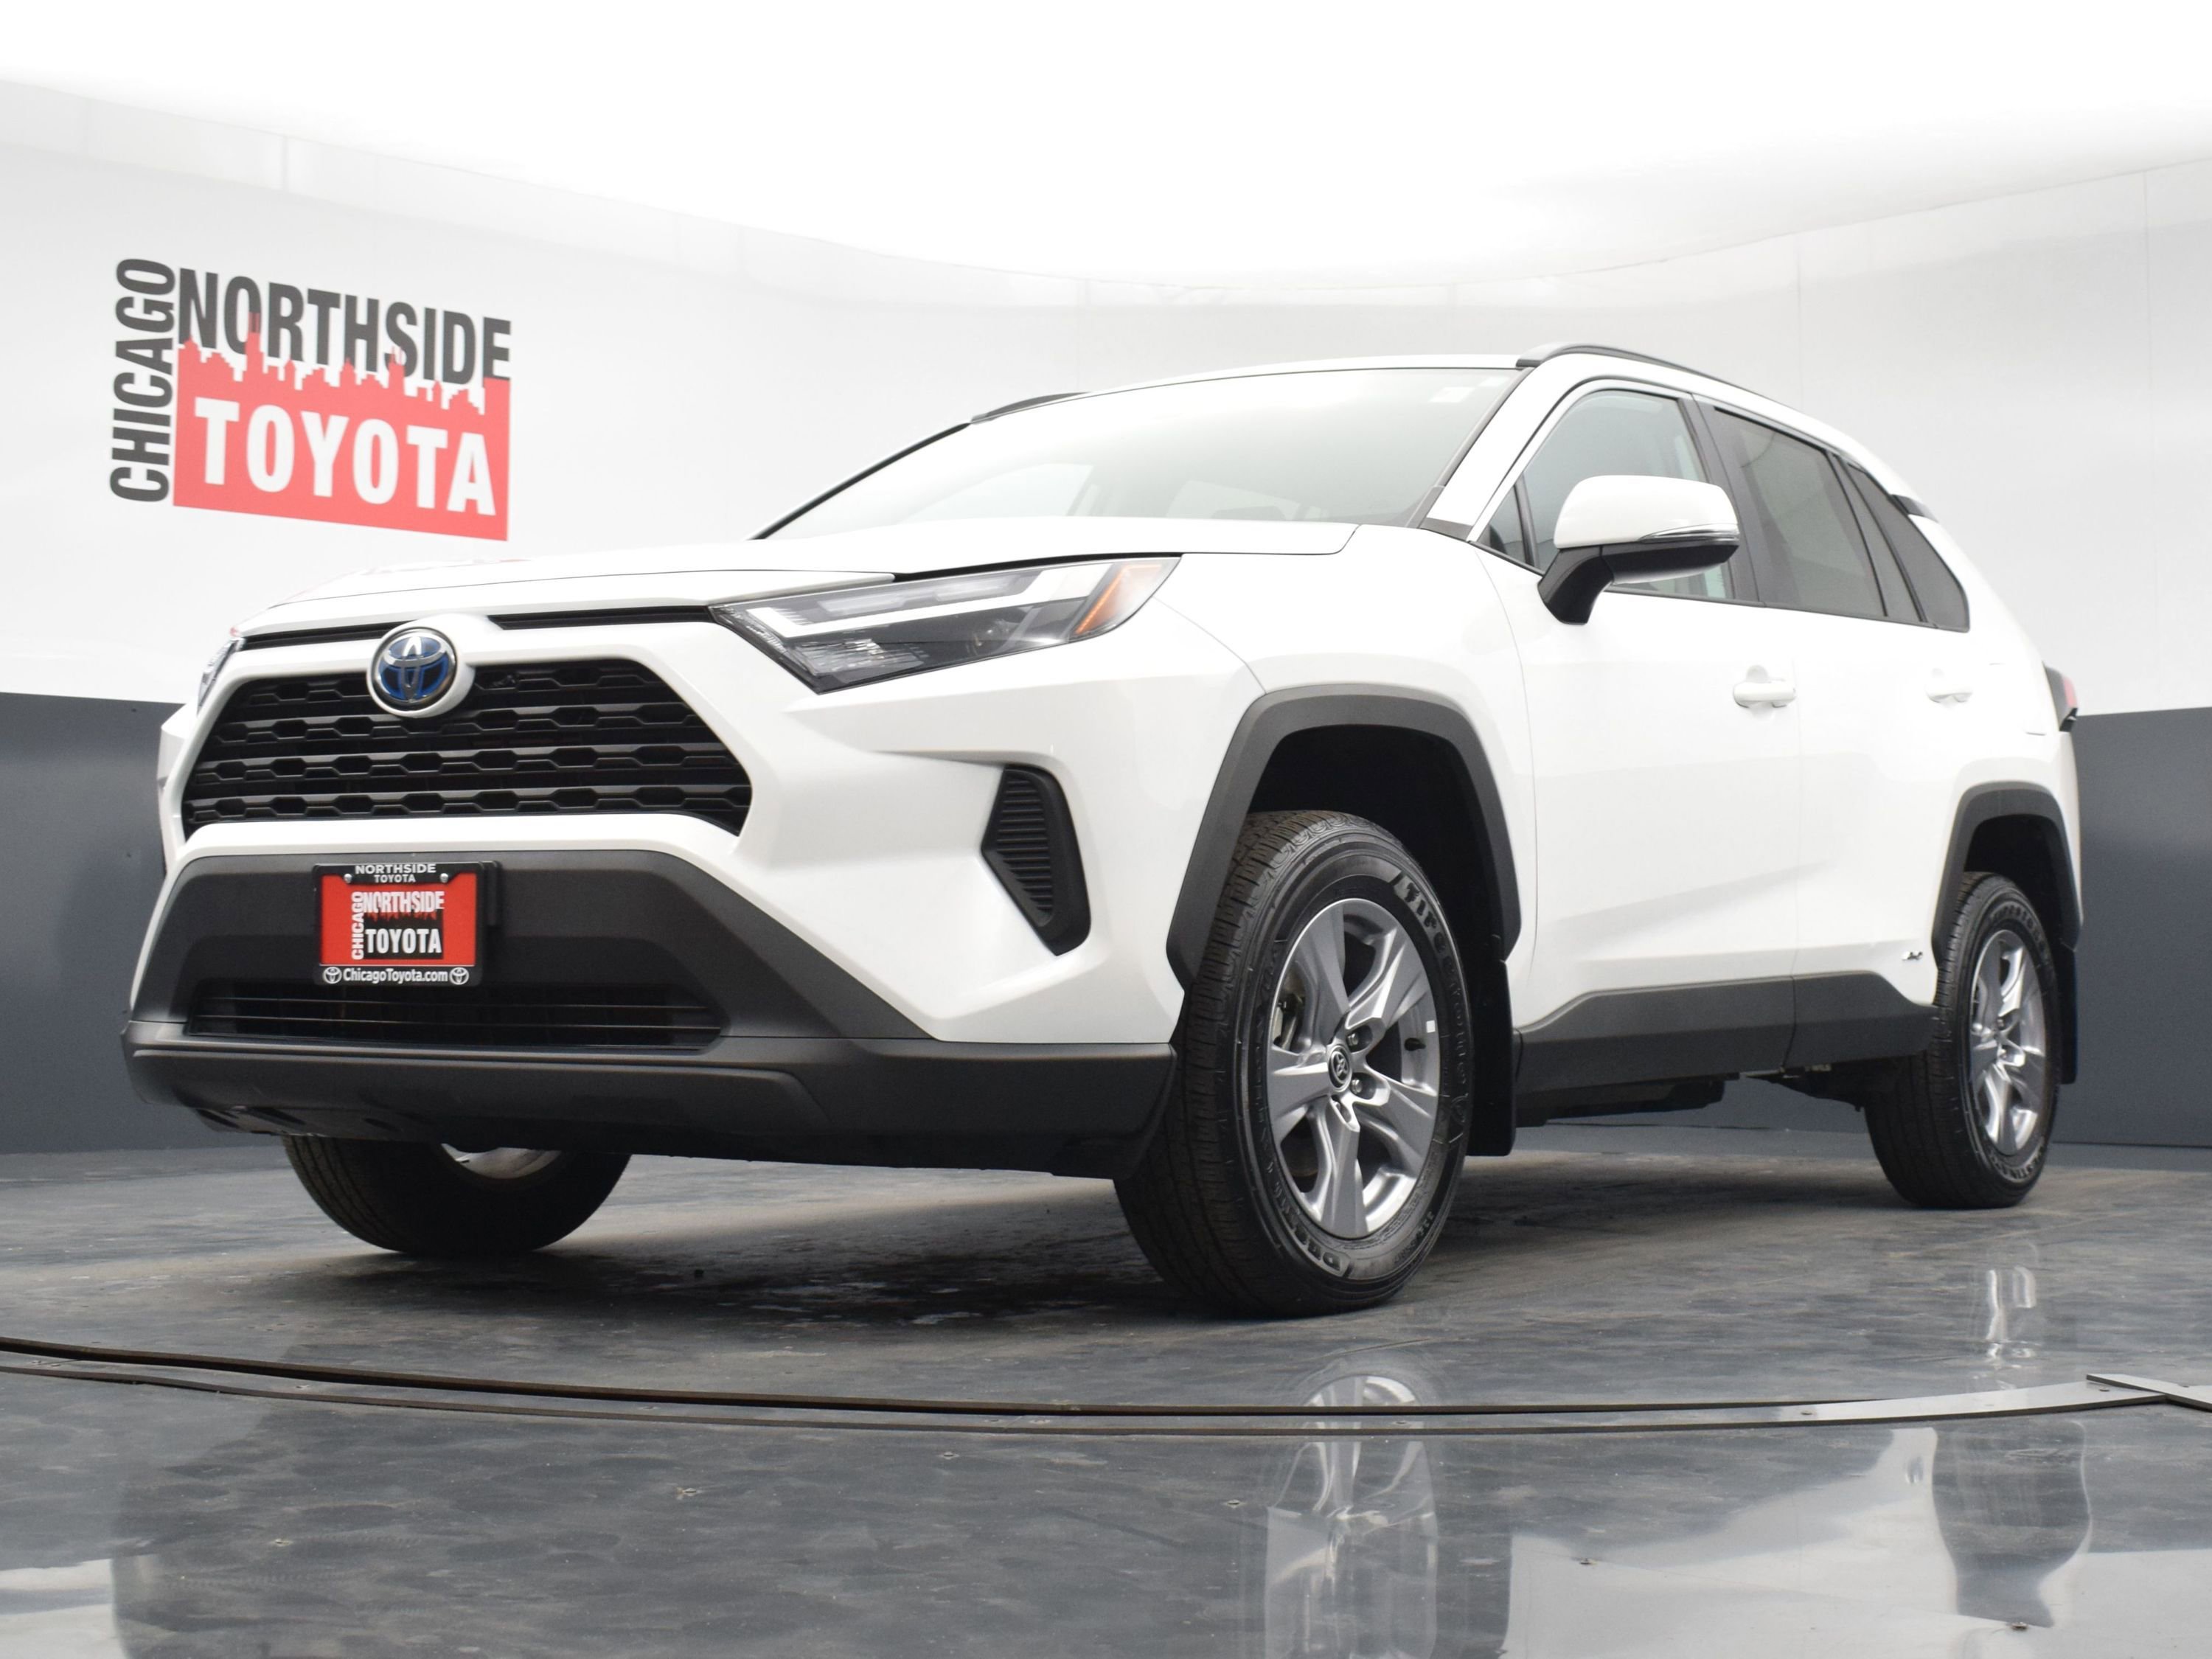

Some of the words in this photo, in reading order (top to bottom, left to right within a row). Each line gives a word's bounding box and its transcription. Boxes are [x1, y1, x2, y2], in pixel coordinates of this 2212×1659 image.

[178, 267, 511, 385] NORTHSIDE
[110, 258, 175, 501] CHICAGO
[195, 397, 495, 516] TOYOTA
[355, 864, 437, 874] NORTHSIDE
[375, 874, 416, 883] TOYOTA
[364, 891, 445, 913] NORTHSIDE
[352, 891, 364, 959] CHICAGO
[366, 928, 442, 953] TOYOTA
[343, 967, 448, 984] ChicagoToyota.com
